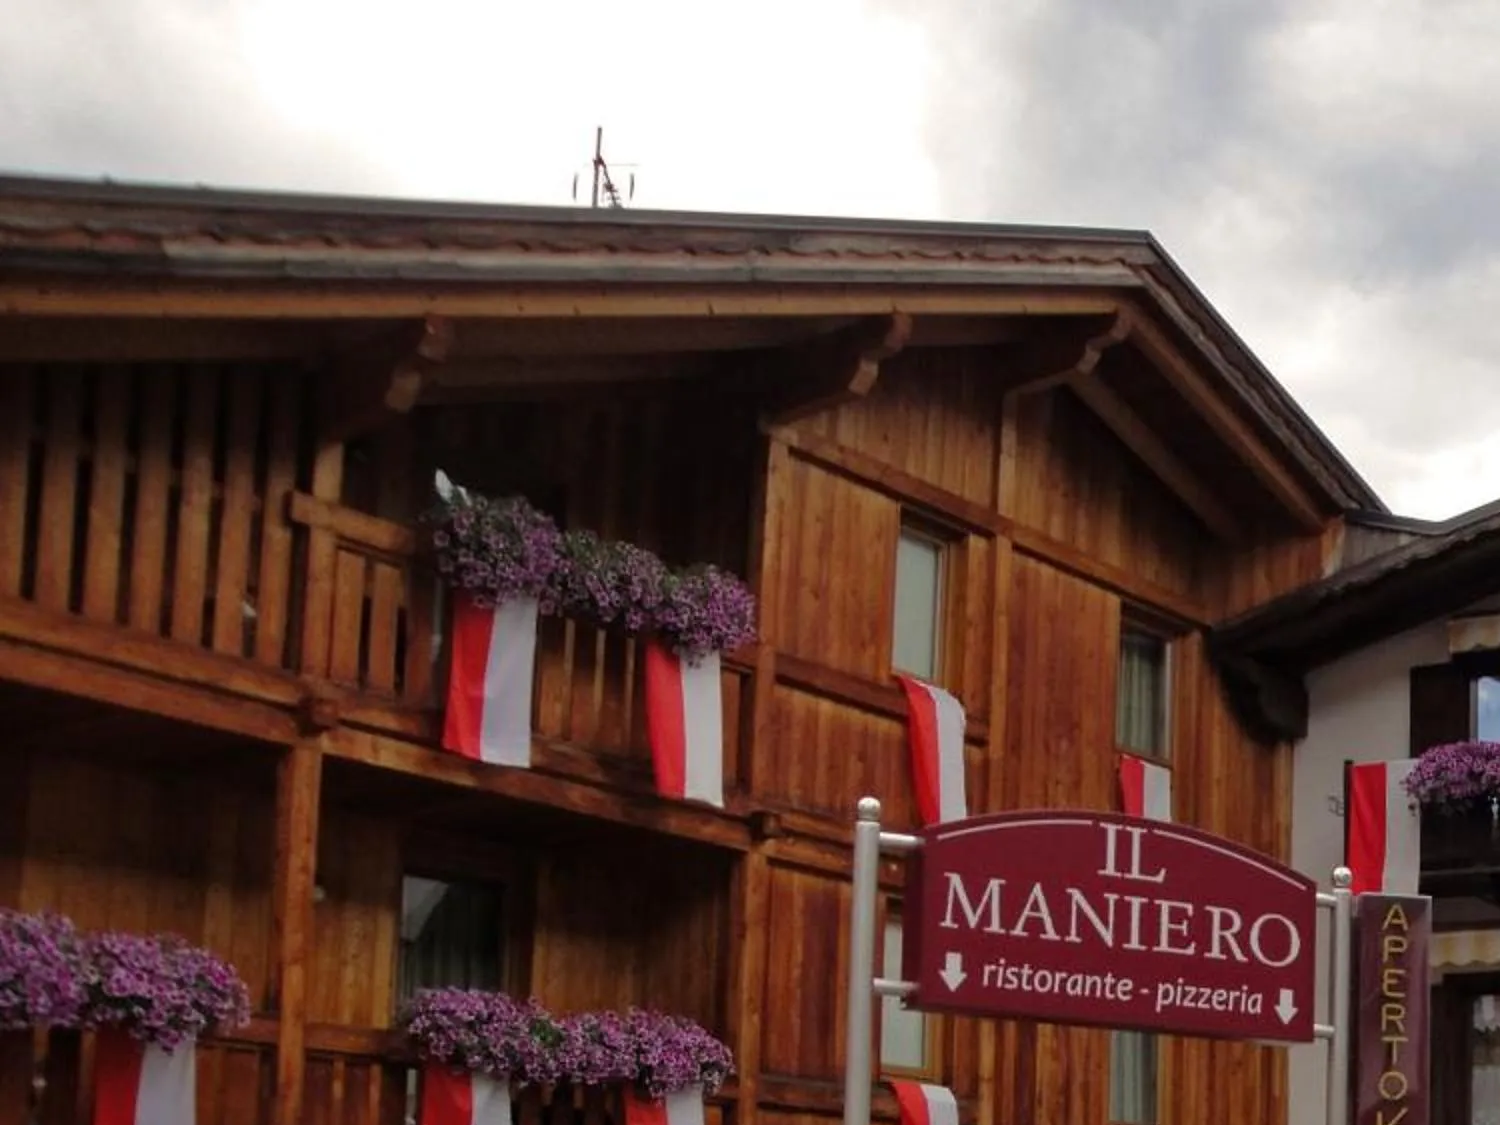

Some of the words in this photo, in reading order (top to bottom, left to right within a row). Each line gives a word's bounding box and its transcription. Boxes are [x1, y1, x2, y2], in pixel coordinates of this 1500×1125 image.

[1097, 822, 1167, 883] IL
[939, 872, 1301, 968] MANIERO
[982, 958, 1133, 1000] ristorante
[1155, 977, 1263, 1013] pizzeria
[1378, 903, 1409, 1100] APERTO
